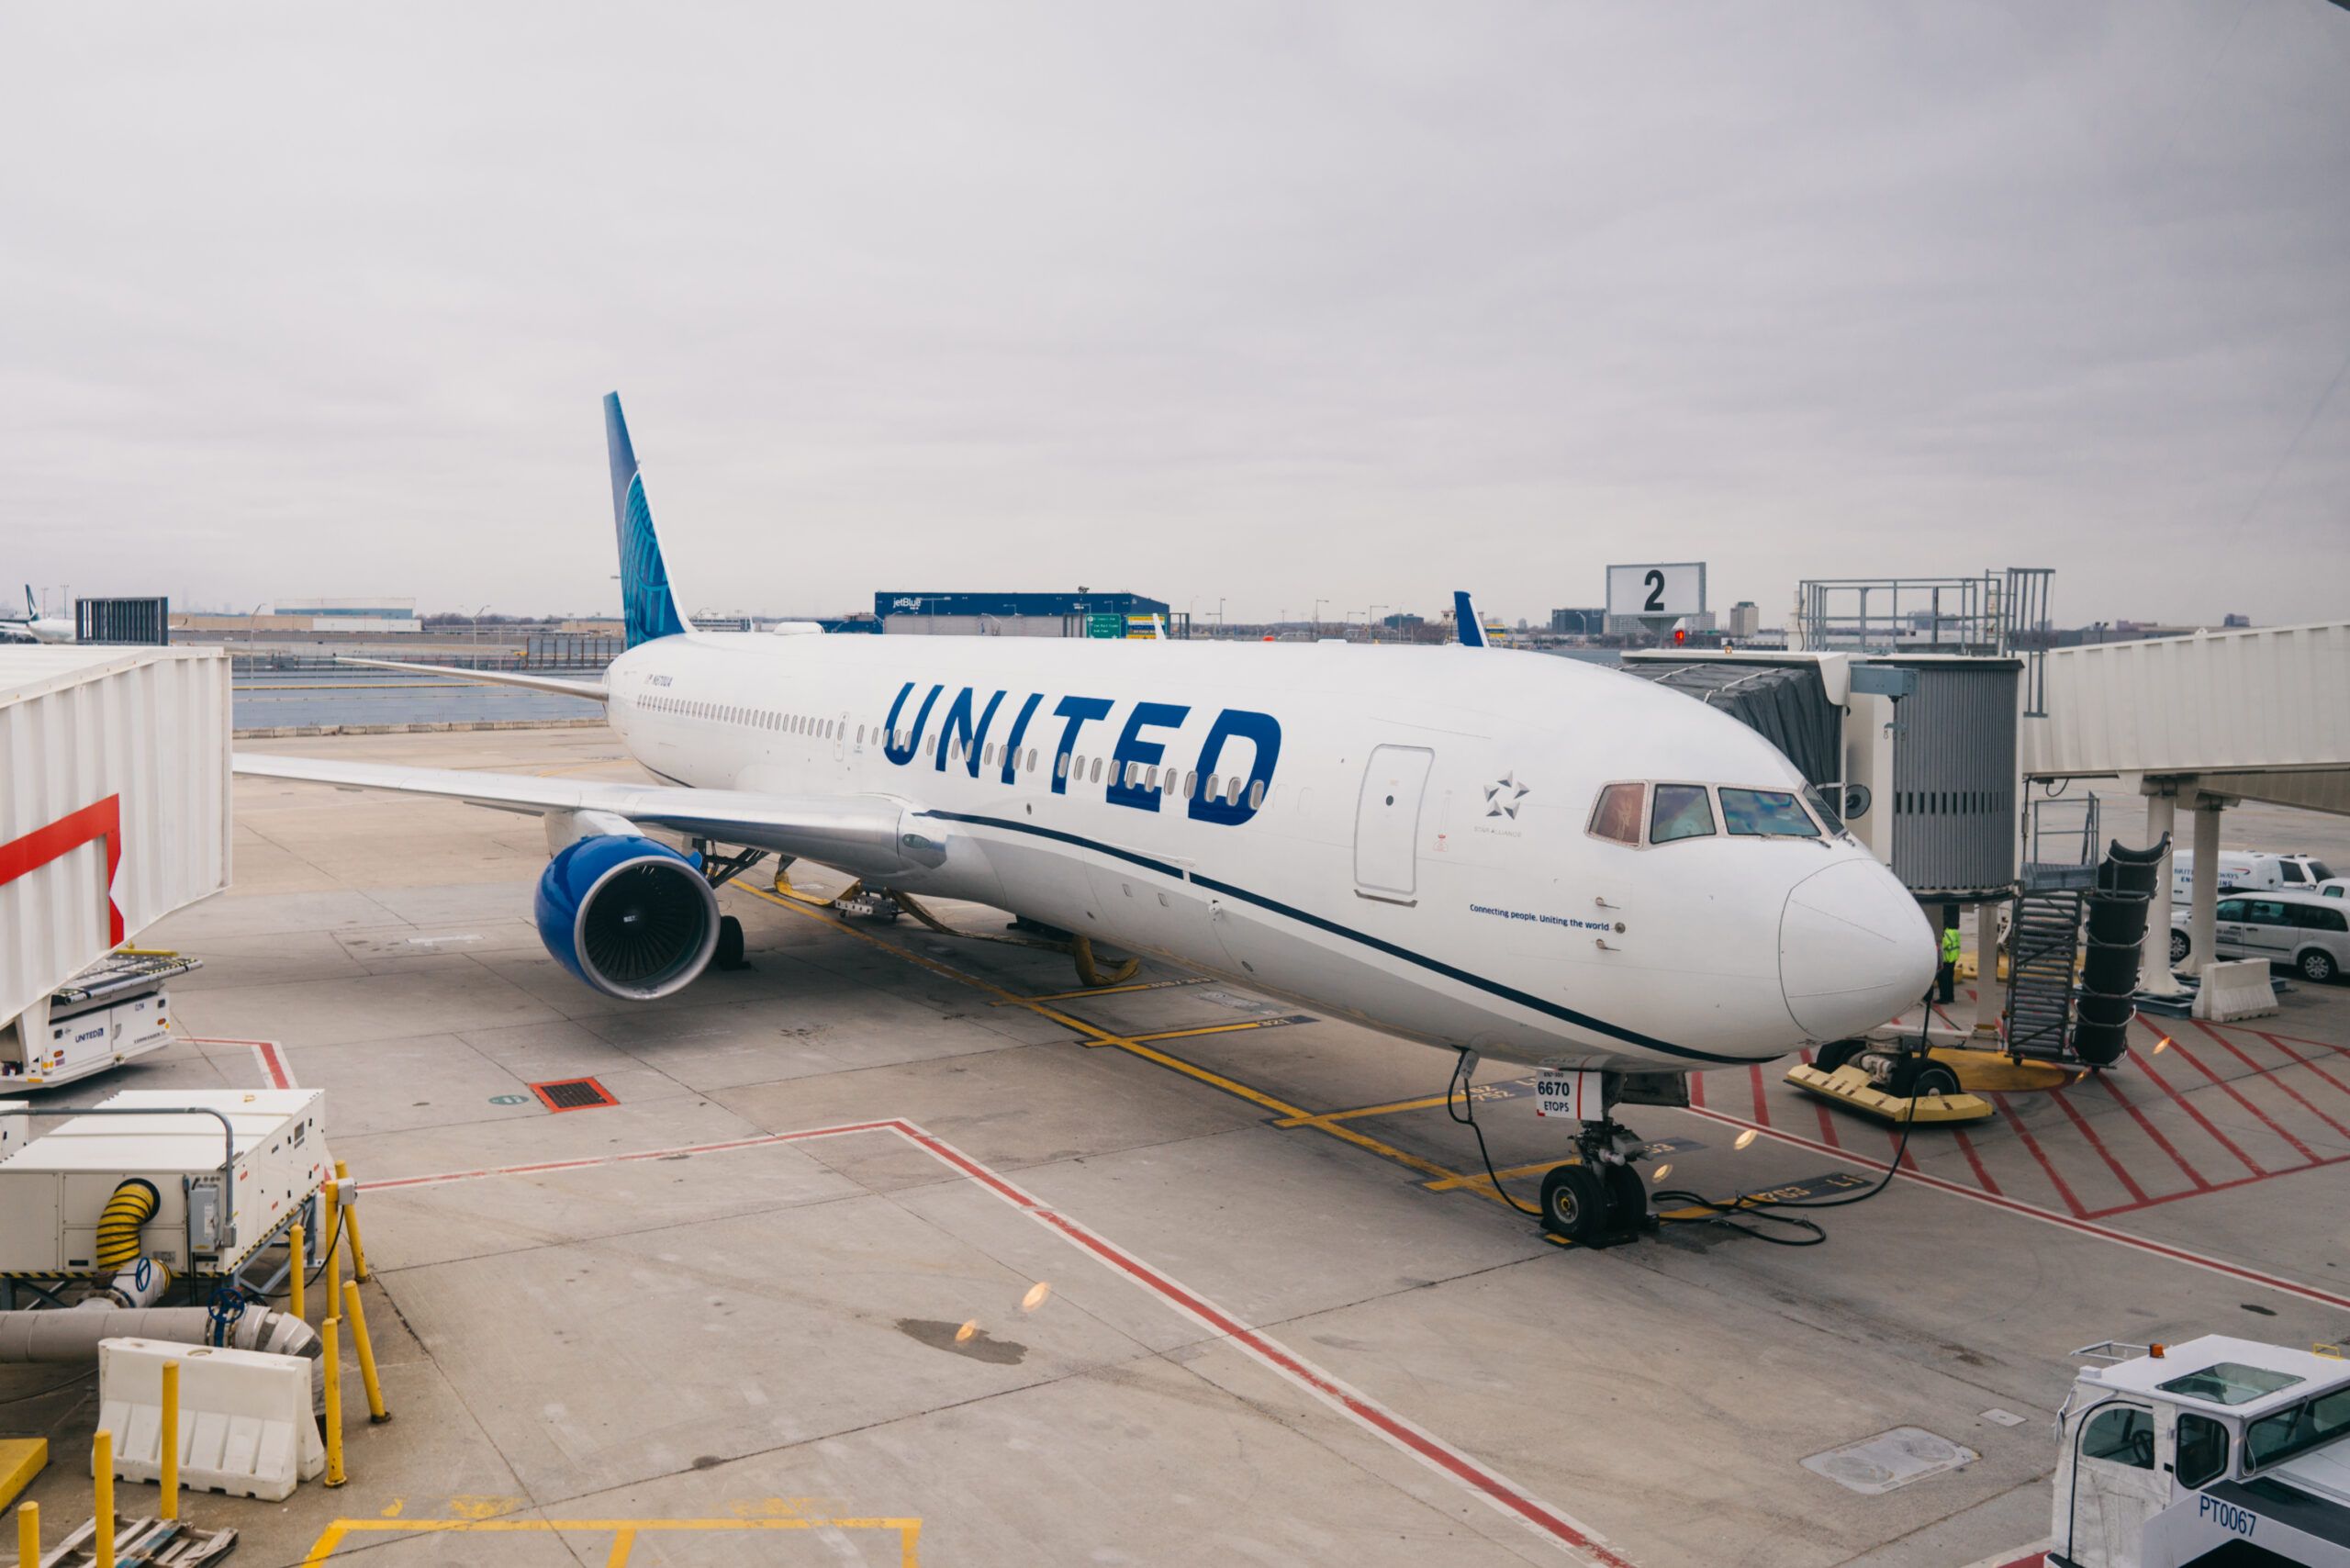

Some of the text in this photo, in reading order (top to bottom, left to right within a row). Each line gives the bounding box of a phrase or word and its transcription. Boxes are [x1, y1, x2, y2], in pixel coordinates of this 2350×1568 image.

[1644, 569, 1665, 611] 2
[893, 597, 922, 609] jetBlue
[883, 682, 1282, 826] UNITED
[1470, 903, 1610, 932] Connecting people. Uniting the world
[75, 1029, 97, 1043] UNITED
[1538, 1081, 1570, 1097] 6670
[1543, 1101, 1570, 1113] ETOPS
[1825, 1175, 1865, 1188] L1
[2199, 1495, 2257, 1538] PT0067
